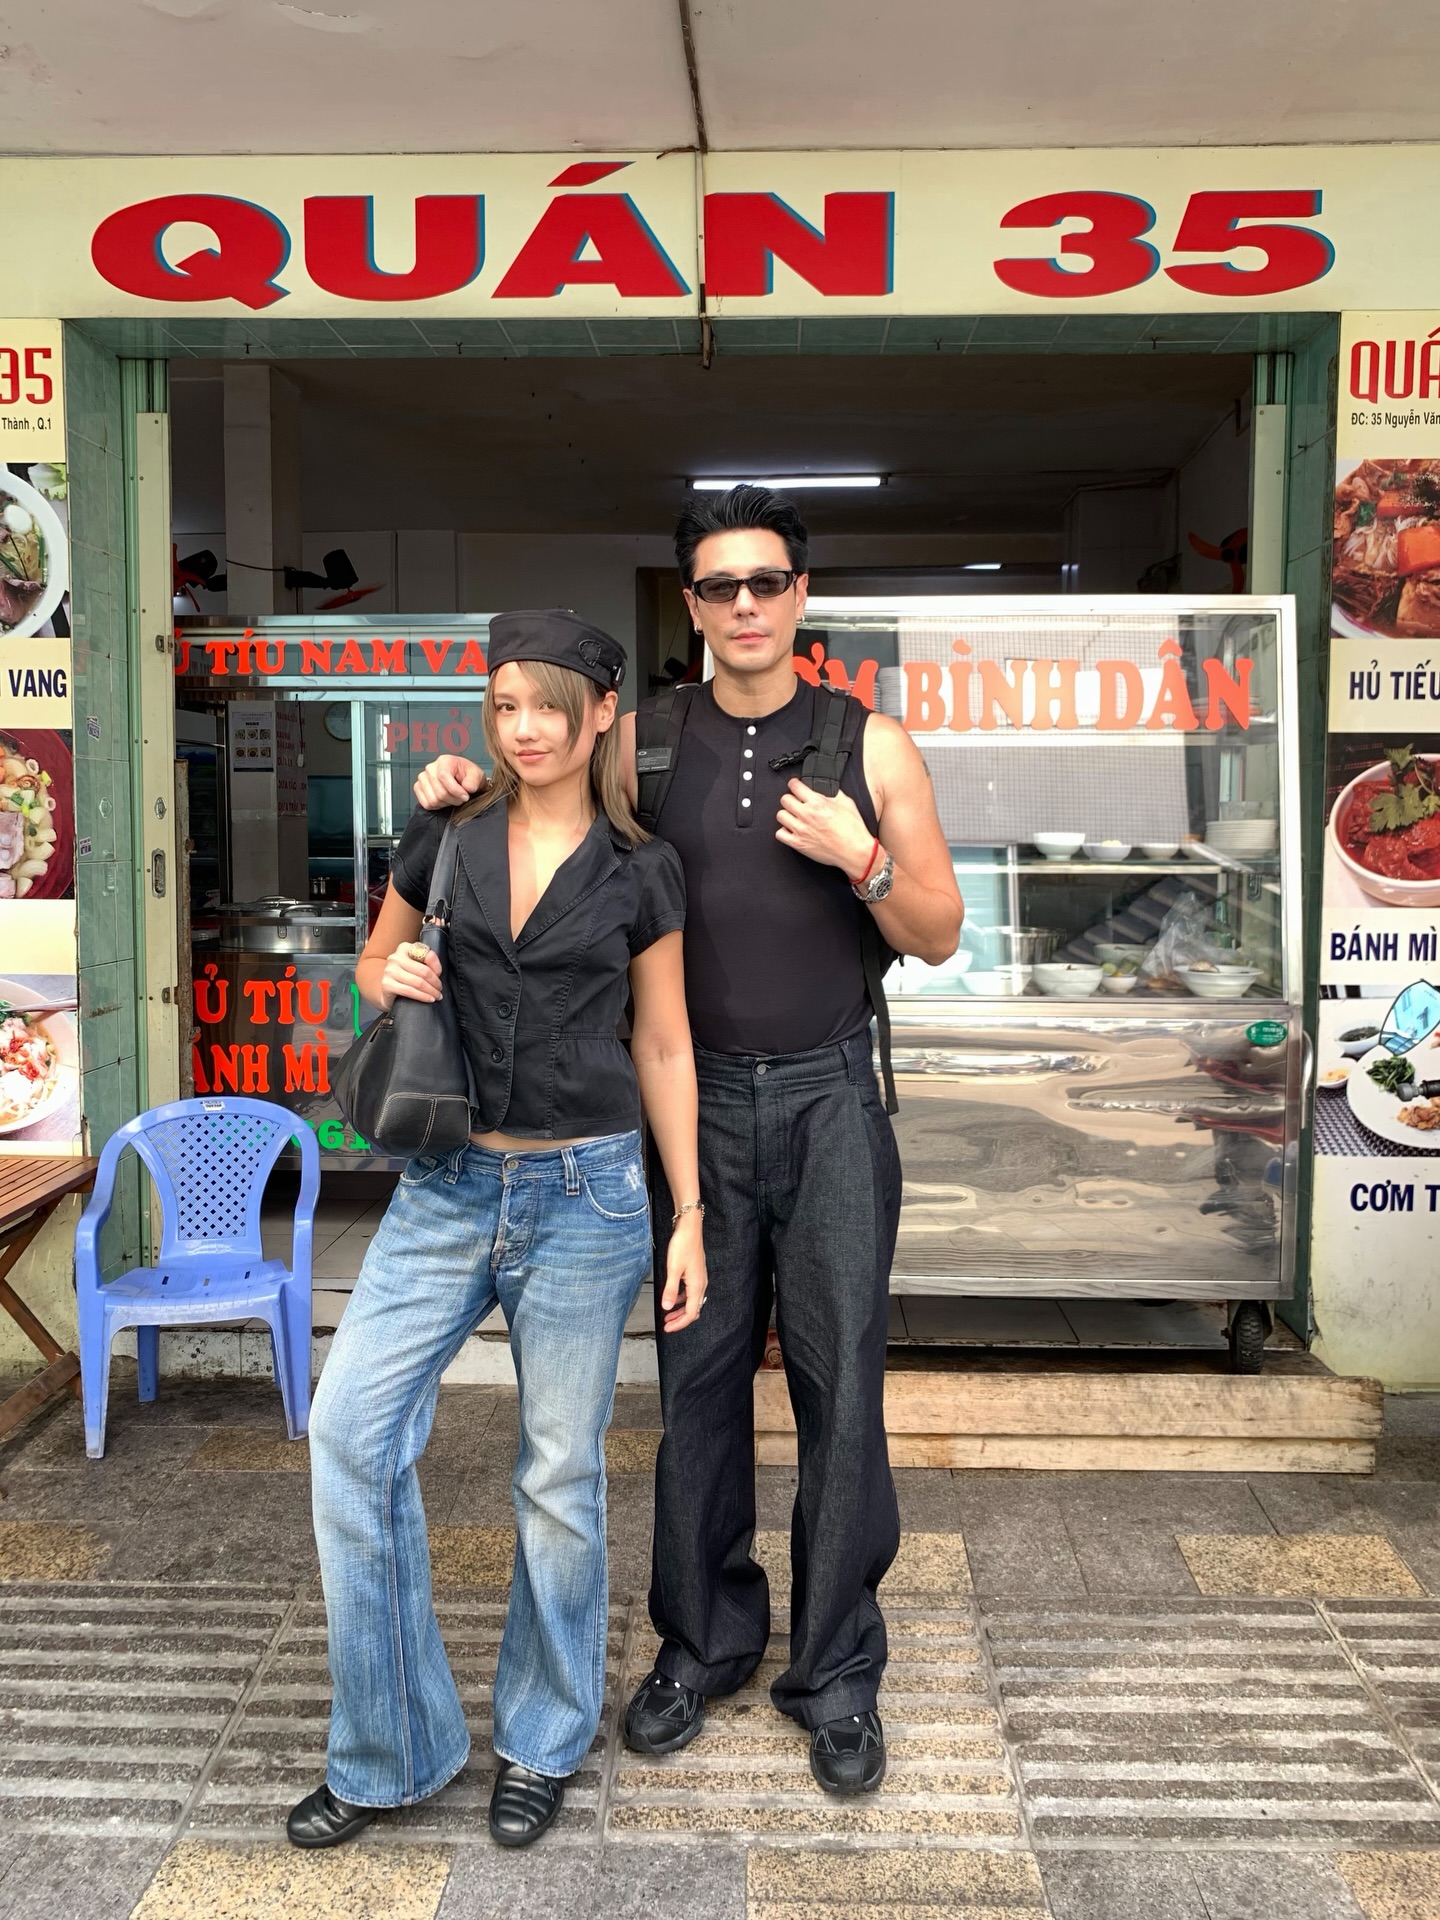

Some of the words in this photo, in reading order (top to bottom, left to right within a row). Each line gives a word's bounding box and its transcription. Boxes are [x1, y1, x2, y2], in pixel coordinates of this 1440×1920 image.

[91, 162, 896, 310] QUÁN
[992, 189, 1337, 299] 35
[37, 416, 52, 430] Q.1
[1350, 412, 1368, 426] ĐC:
[1371, 412, 1382, 426] 35
[1384, 409, 1421, 429] Nguyễn
[204, 627, 287, 676] TÍU
[299, 637, 408, 675] NAM
[418, 637, 489, 675] VA
[8, 668, 68, 698] VANG
[902, 639, 1080, 732] BÌNH
[1096, 637, 1255, 731] DÂN
[1349, 659, 1381, 701] HỦ
[1390, 659, 1440, 701] TIẾU
[383, 706, 472, 753] PHỞ
[1330, 924, 1399, 962] BÁNH
[1407, 925, 1438, 962] MÌ
[242, 964, 333, 1026] TÍU
[281, 1028, 332, 1095] MÌ
[1350, 1178, 1415, 1213] CƠM
